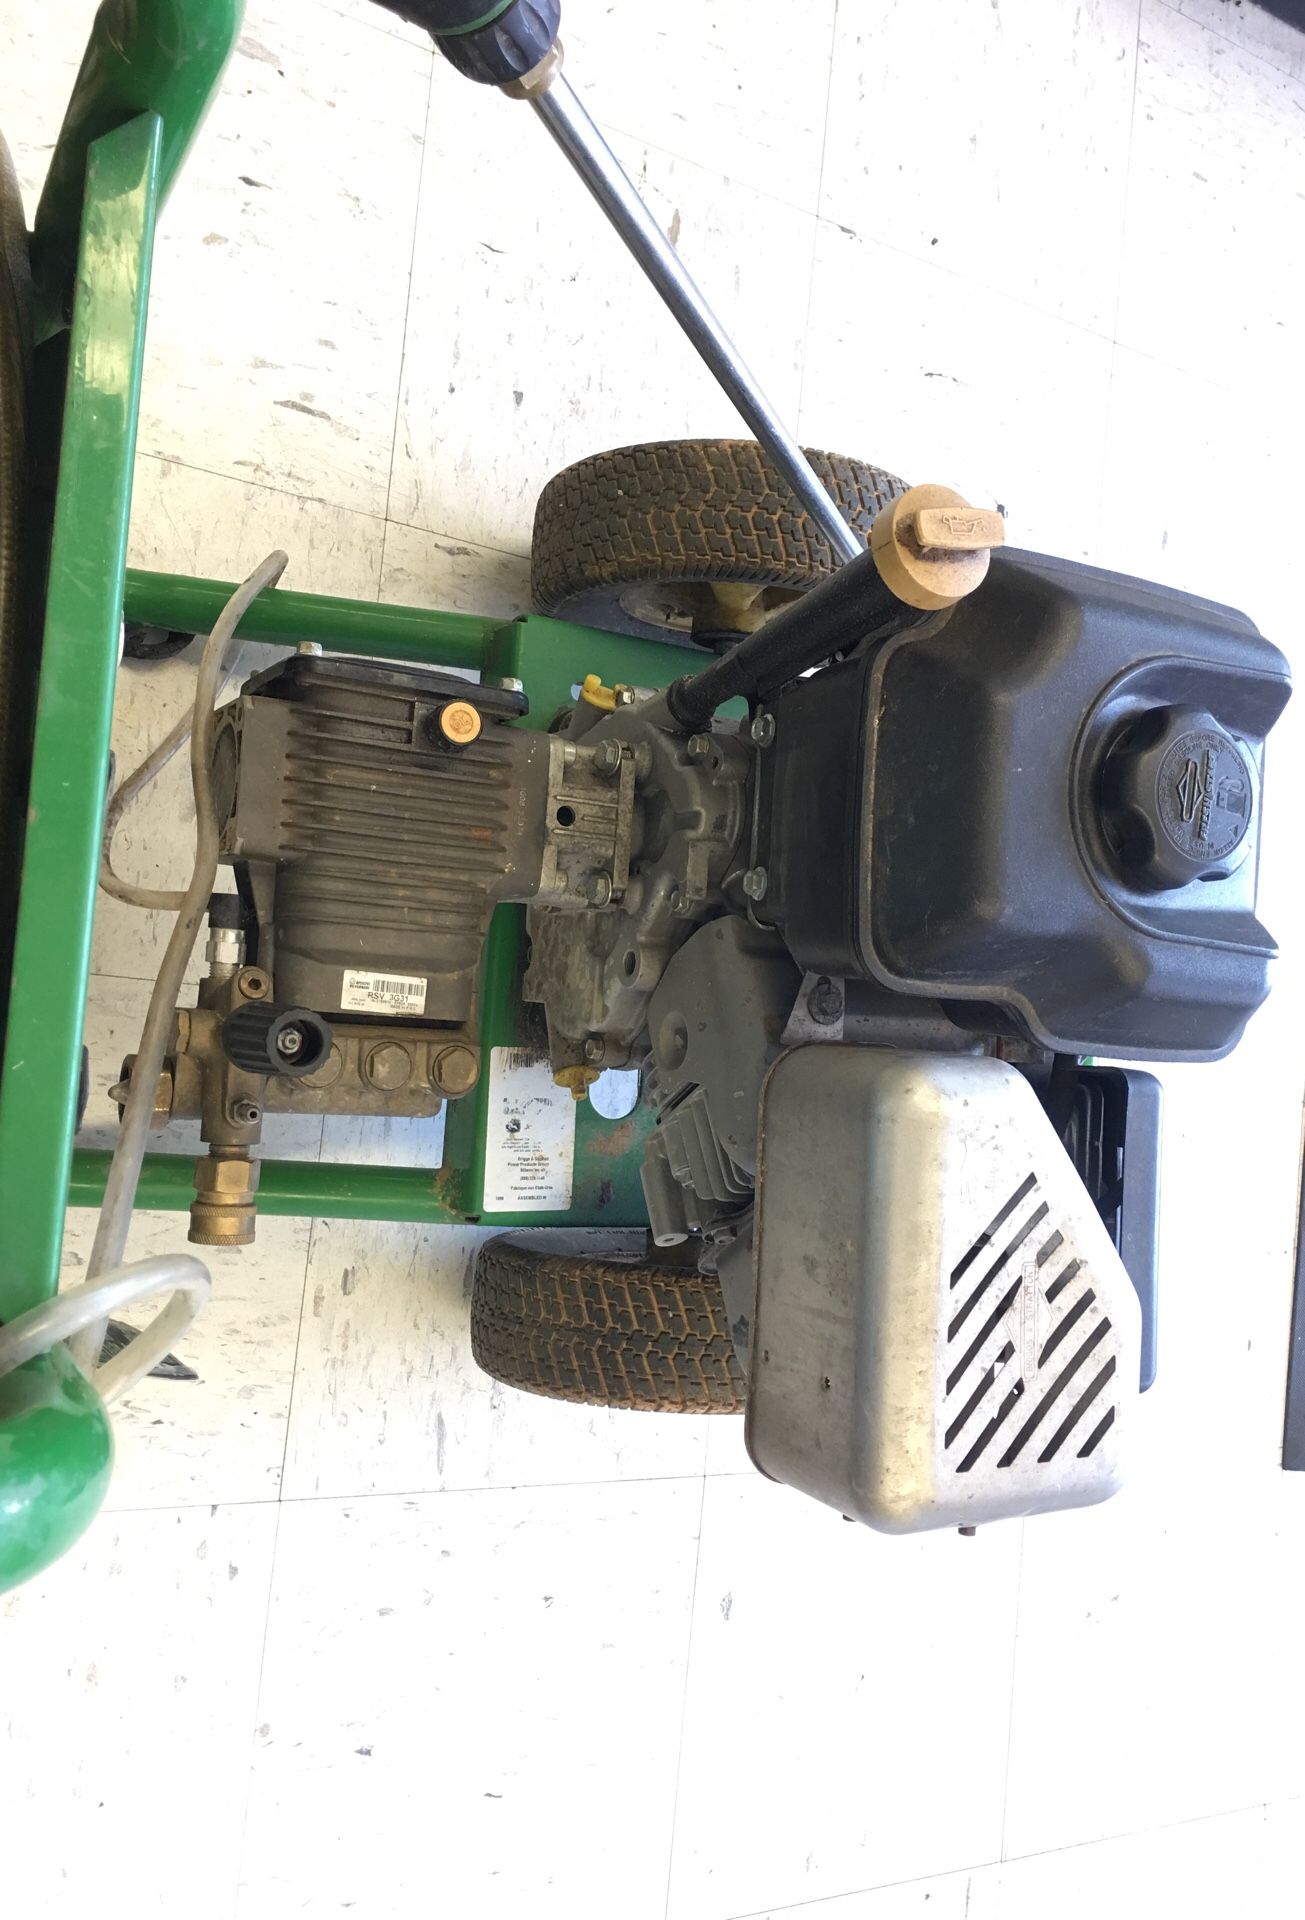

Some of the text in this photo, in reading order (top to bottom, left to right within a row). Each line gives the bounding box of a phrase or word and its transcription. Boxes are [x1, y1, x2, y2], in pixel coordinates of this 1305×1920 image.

[367, 991, 385, 1000] RSV
[389, 993, 409, 1002] 3G31
[1024, 1271, 1034, 1321] STRATTON
